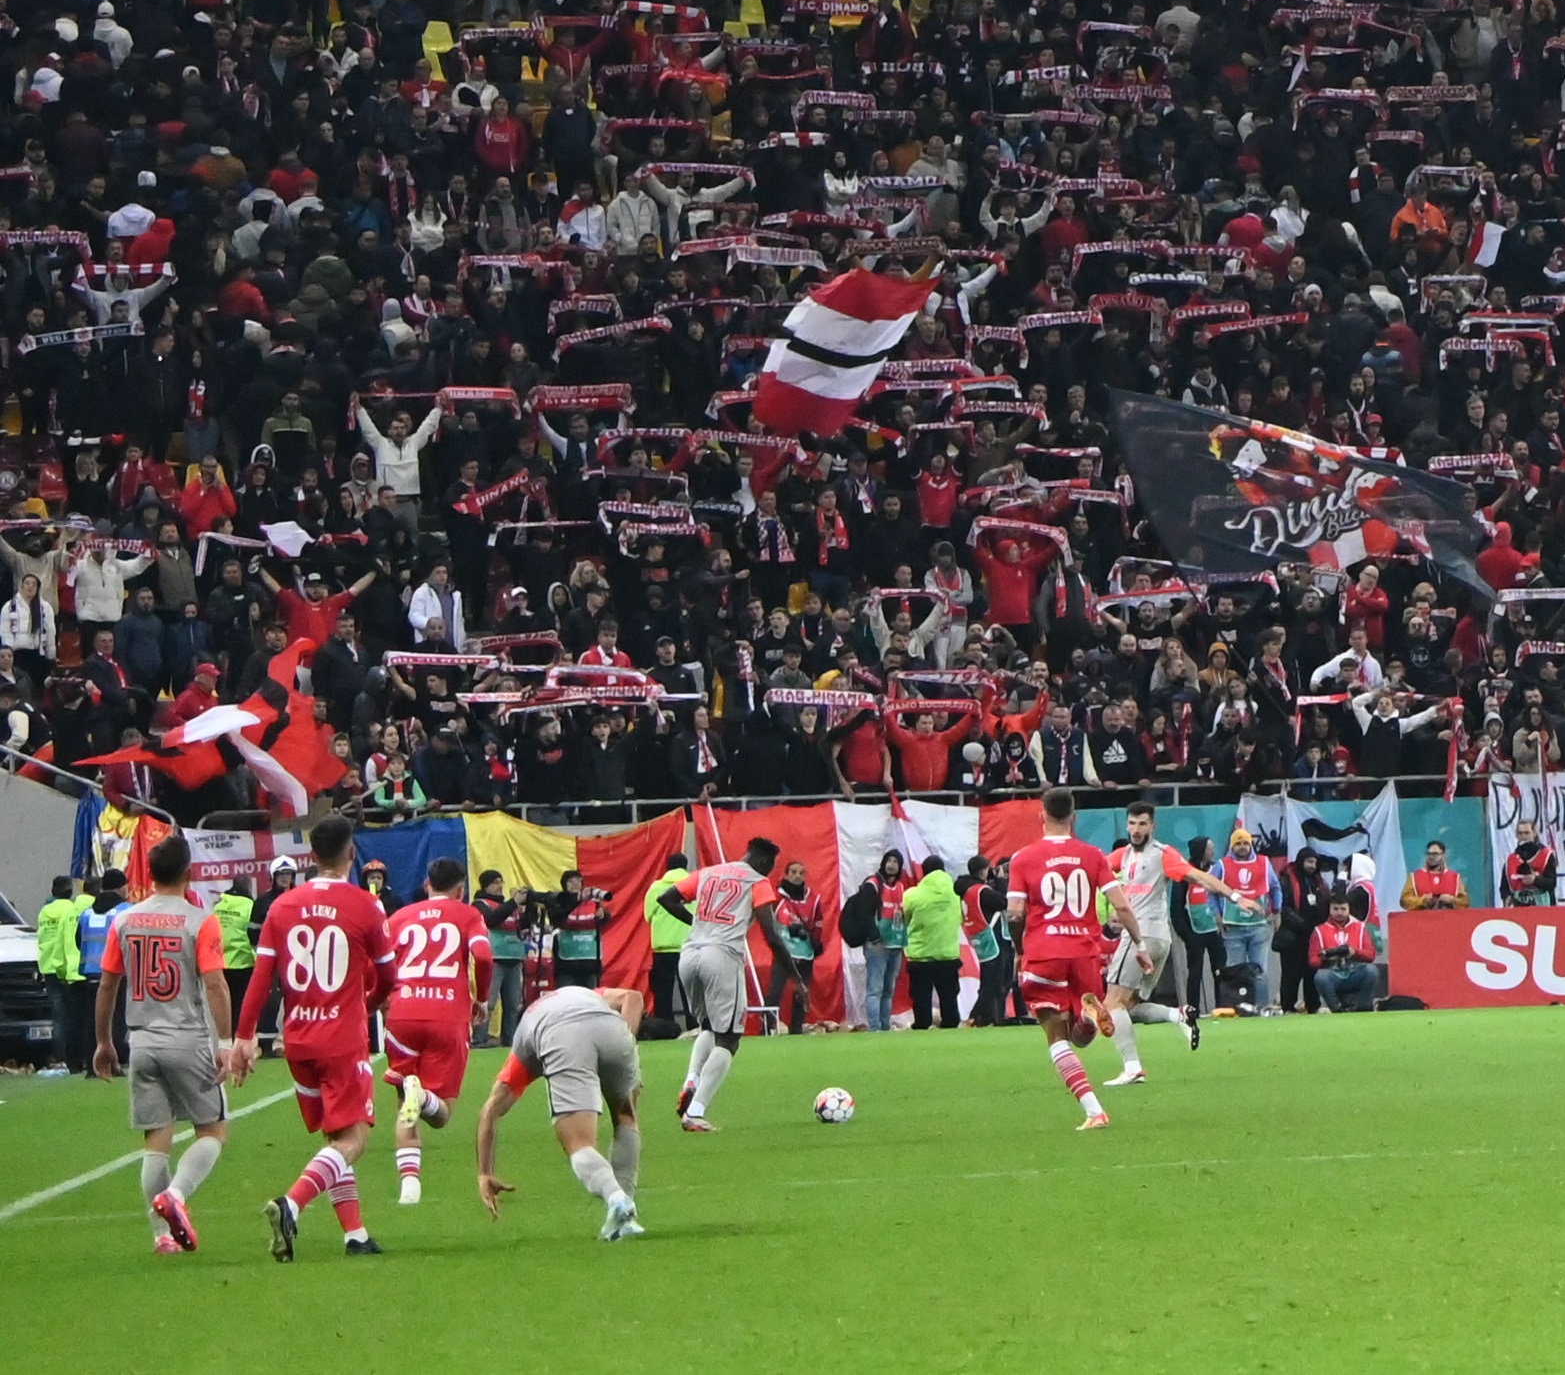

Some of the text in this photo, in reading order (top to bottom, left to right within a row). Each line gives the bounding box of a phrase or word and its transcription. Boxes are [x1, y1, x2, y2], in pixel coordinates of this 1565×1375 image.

[822, 2, 870, 14] DINAMO
[200, 862, 232, 877] DDB
[1040, 868, 1090, 921] 90
[313, 905, 338, 922] LUNA
[126, 935, 183, 1002] 15
[287, 925, 350, 993] 80
[398, 923, 461, 980] 22
